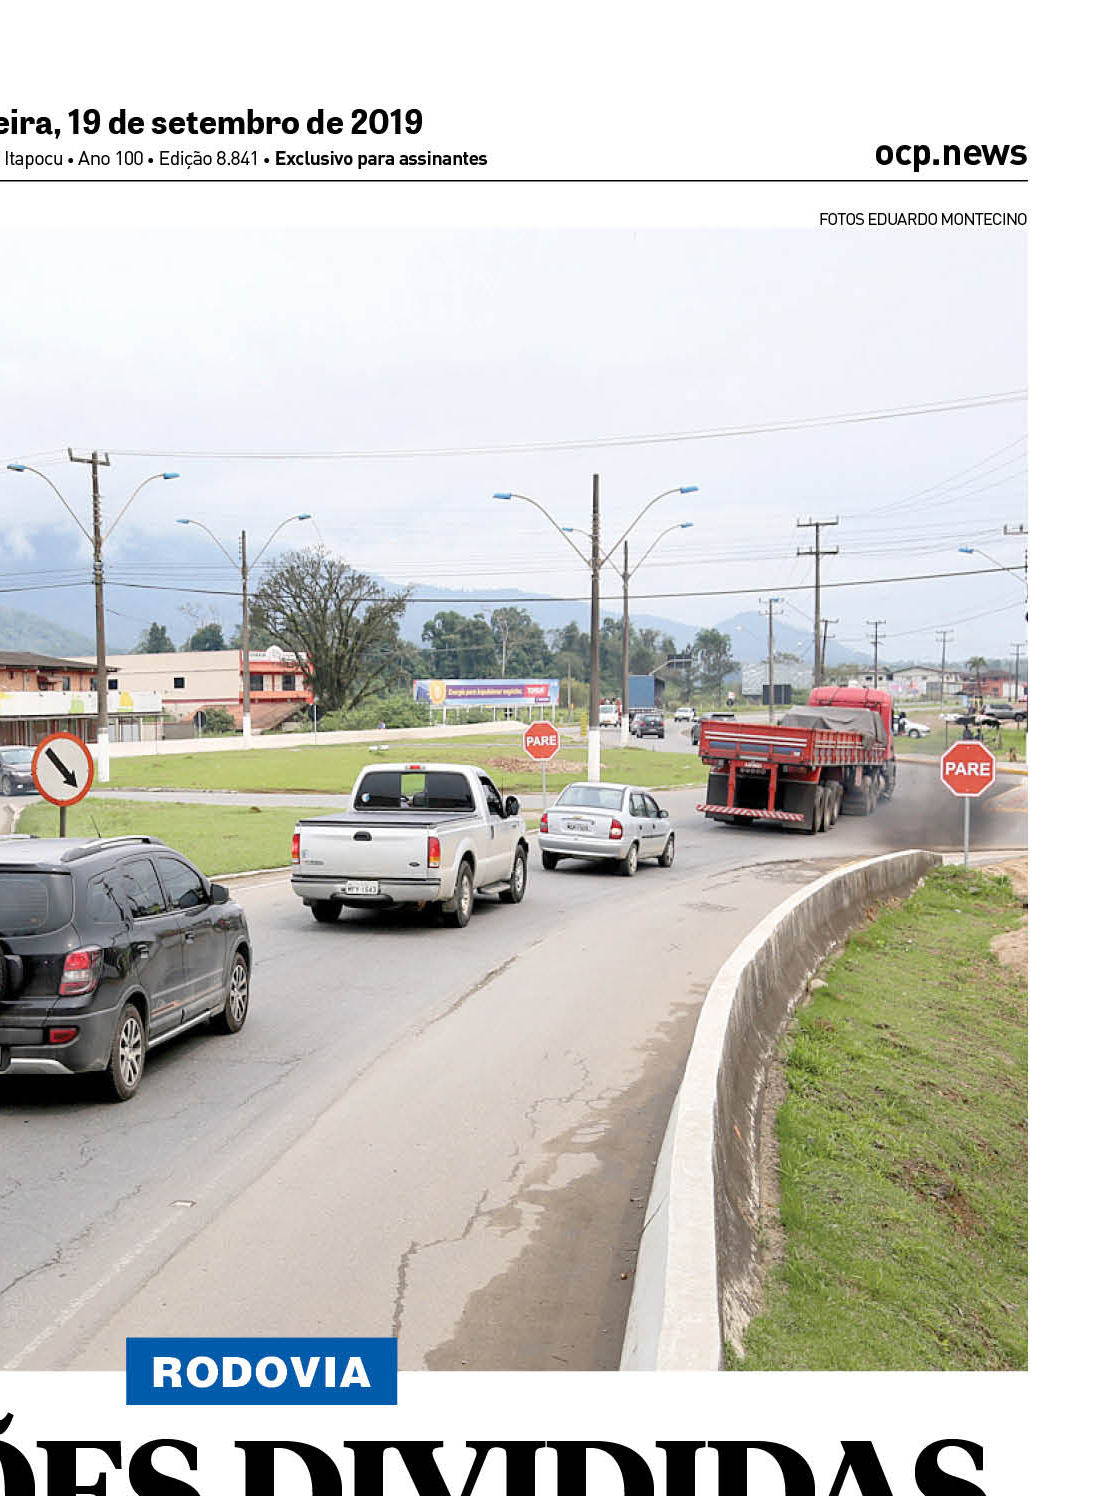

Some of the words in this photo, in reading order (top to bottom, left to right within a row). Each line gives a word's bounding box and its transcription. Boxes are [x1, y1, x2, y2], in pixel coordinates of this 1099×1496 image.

[67, 108, 101, 135] 19
[108, 108, 145, 135] de
[151, 108, 300, 135] setembro
[306, 108, 344, 135] de
[351, 108, 423, 135] 2019
[5, 150, 63, 170] Itapocu
[77, 150, 111, 166] Ano
[116, 150, 144, 166] 100
[159, 150, 213, 170] Edição
[216, 150, 257, 166] 8.841
[275, 150, 354, 166] Exclusivo
[357, 154, 395, 170] para
[398, 150, 488, 166] assinantes
[875, 144, 1028, 173] ocp.news
[819, 212, 865, 226] FOTOS
[868, 212, 938, 226] EDUARDO
[941, 212, 1028, 226] MONTECINO
[526, 735, 557, 747] PARE
[945, 759, 991, 777] PARE
[153, 1355, 372, 1389] RODOVIA
